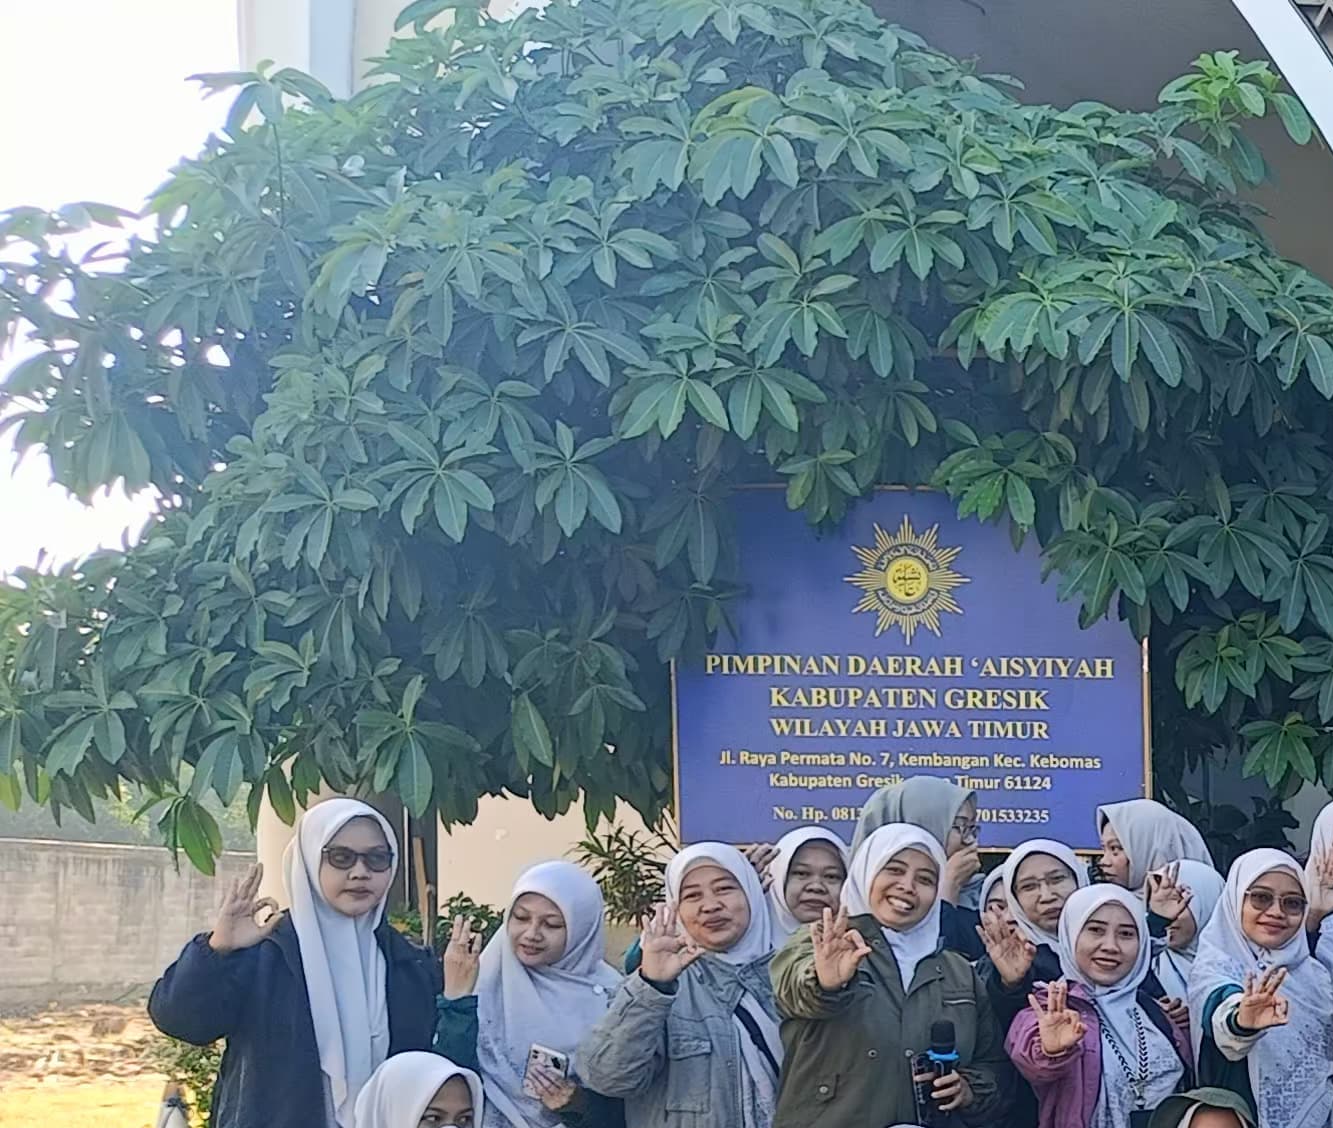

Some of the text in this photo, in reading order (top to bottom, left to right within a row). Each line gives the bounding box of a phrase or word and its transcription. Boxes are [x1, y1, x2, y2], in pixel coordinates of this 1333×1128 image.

[705, 655, 840, 676] PIMPINAN
[847, 655, 964, 677] DAERAH
[769, 687, 1050, 710] KABUPATEN GRESIK
[769, 718, 1049, 740] WILAYAH JAWA TIMUR
[719, 751, 1102, 770] Jl. Raya Permata No. 7, Kembangan Kec. Kebomas
[769, 774, 852, 790] Kabupaten
[856, 774, 904, 788] Gresik
[954, 776, 1001, 790] Timur
[1003, 776, 1052, 790] 61124
[772, 806, 798, 821] No.
[802, 807, 829, 824] Hp.
[975, 808, 1050, 823] 701533235
